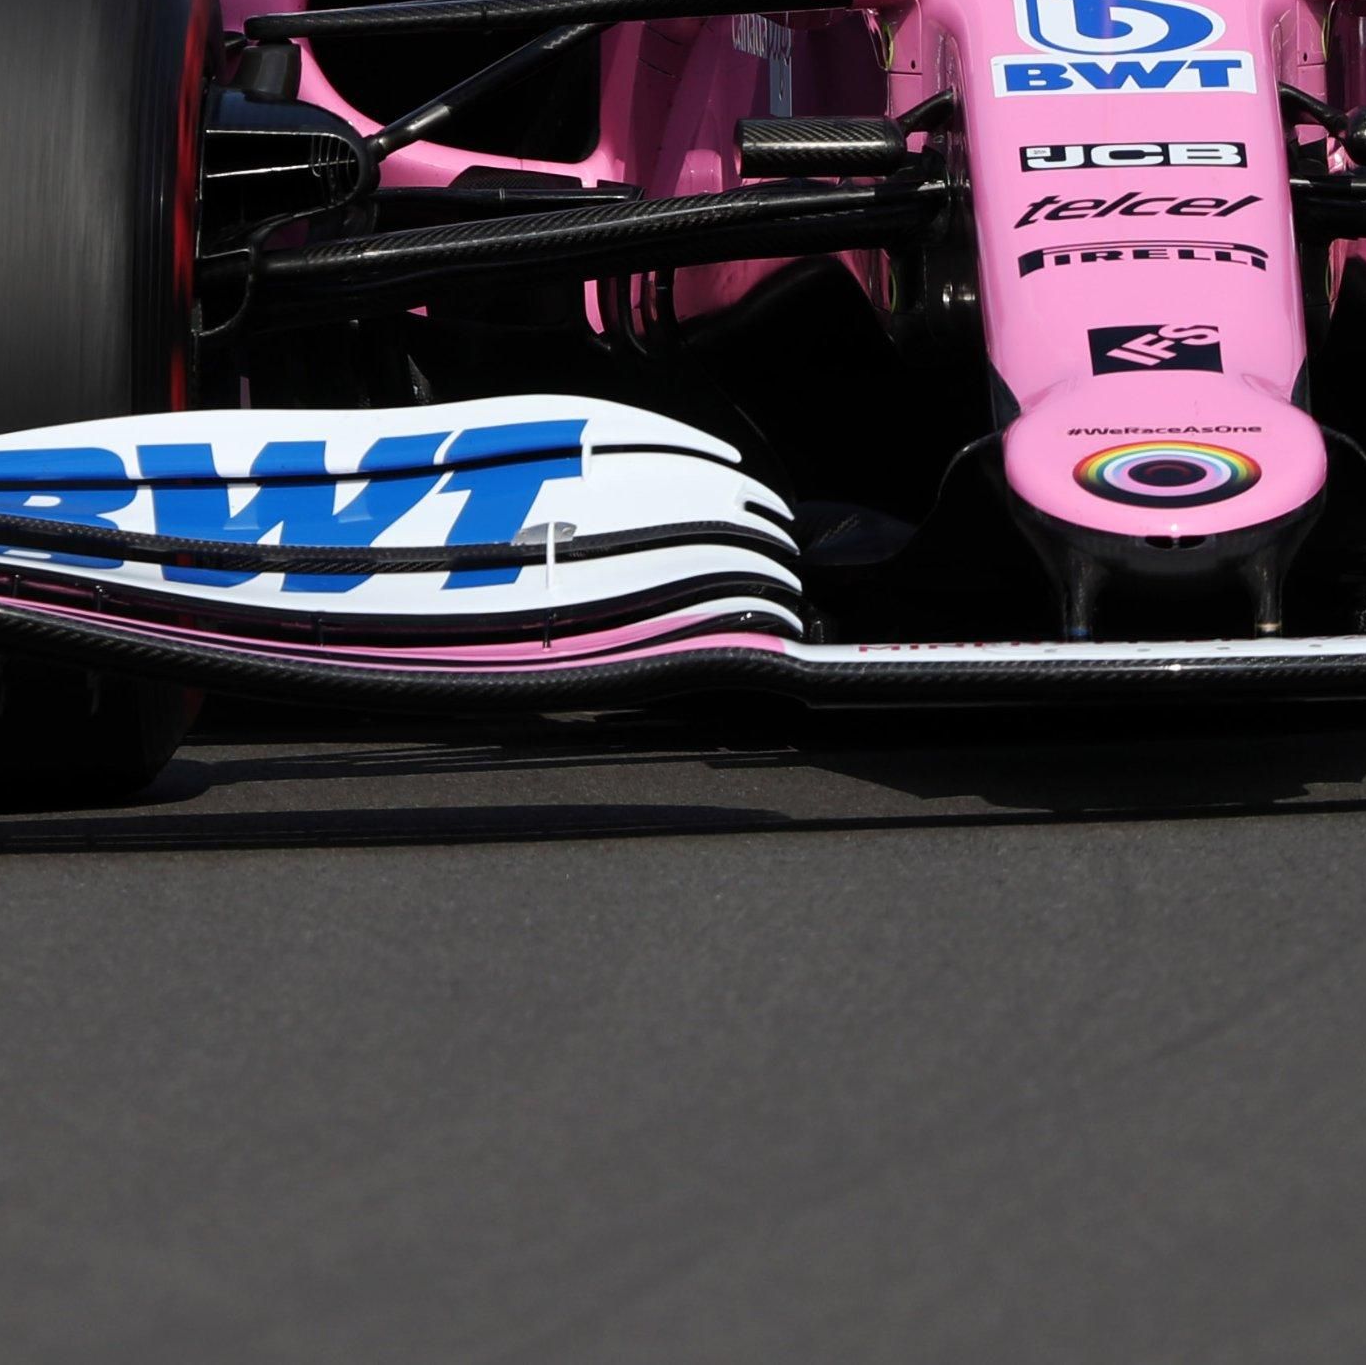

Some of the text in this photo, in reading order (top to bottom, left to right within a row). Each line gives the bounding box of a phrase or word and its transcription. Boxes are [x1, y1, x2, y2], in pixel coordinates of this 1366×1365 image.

[1004, 60, 1242, 92] BWT
[1026, 144, 1242, 169] JCB
[1014, 192, 1263, 229] telcel
[1018, 240, 1268, 278] PIRELLI
[1106, 324, 1220, 366] IFS
[1068, 425, 1262, 435] #WeRaceAsOne
